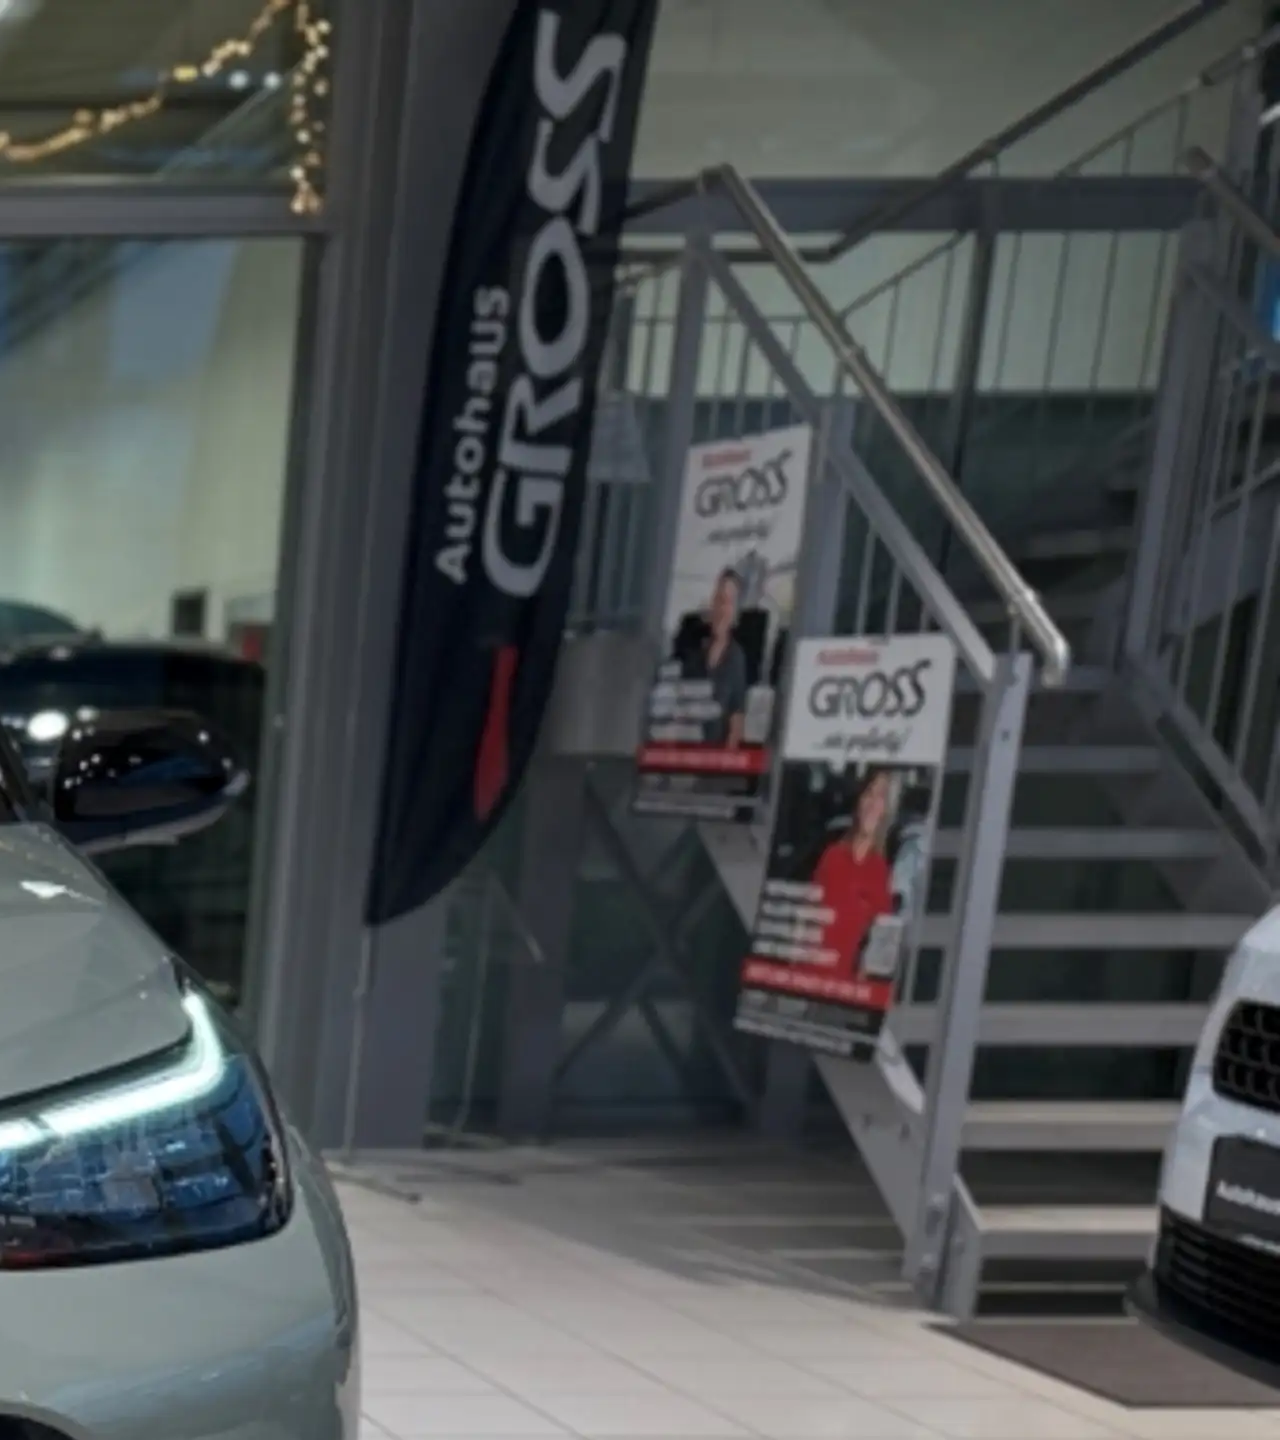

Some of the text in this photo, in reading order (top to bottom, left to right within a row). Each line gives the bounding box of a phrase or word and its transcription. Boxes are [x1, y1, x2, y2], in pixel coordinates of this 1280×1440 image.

[435, 284, 510, 585] Autohaus
[481, 9, 627, 598] GROSS
[808, 657, 932, 720] GROSS
